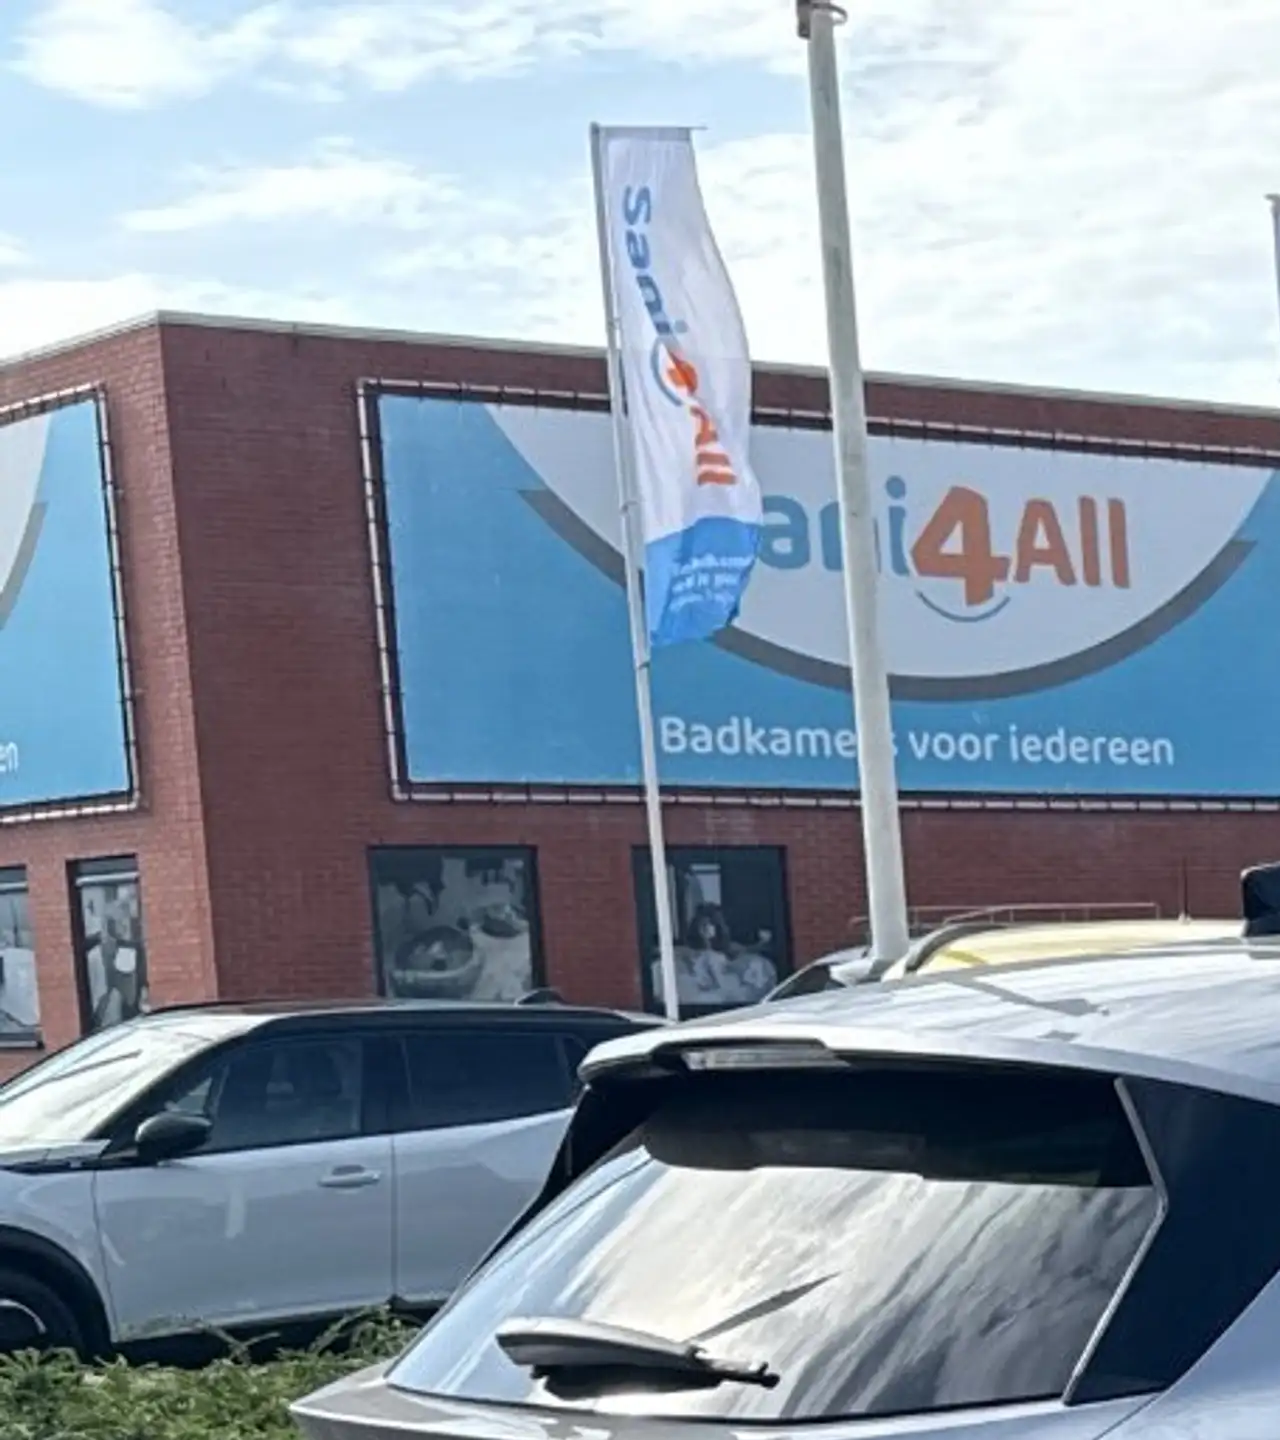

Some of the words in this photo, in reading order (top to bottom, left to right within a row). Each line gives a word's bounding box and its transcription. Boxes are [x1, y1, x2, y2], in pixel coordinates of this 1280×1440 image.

[759, 475, 1131, 607] ai4All
[660, 715, 898, 761] Badkame
[909, 729, 999, 762] voor
[1009, 724, 1175, 766] iedereen
